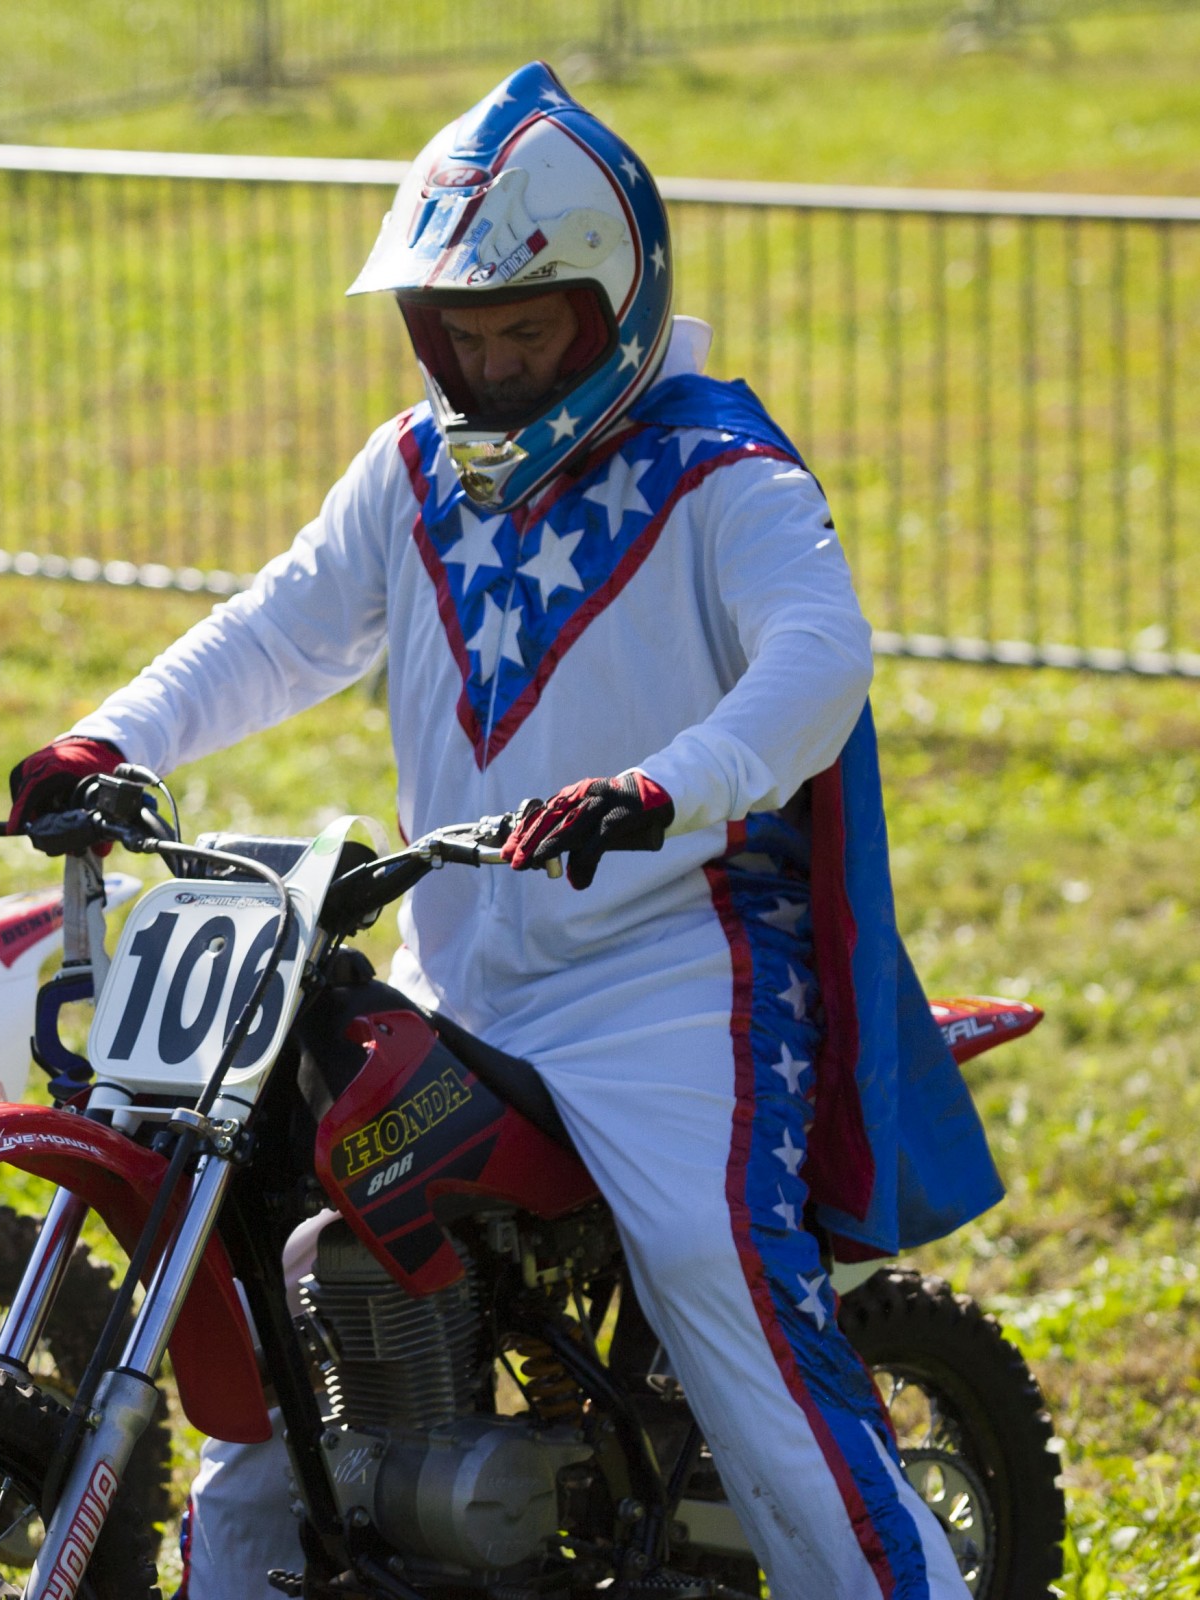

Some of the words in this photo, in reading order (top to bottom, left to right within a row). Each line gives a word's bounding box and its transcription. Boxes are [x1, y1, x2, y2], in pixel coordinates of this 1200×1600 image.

[107, 911, 299, 1070] 106
[344, 1068, 472, 1176] HONDA
[367, 1151, 413, 1197] 80R
